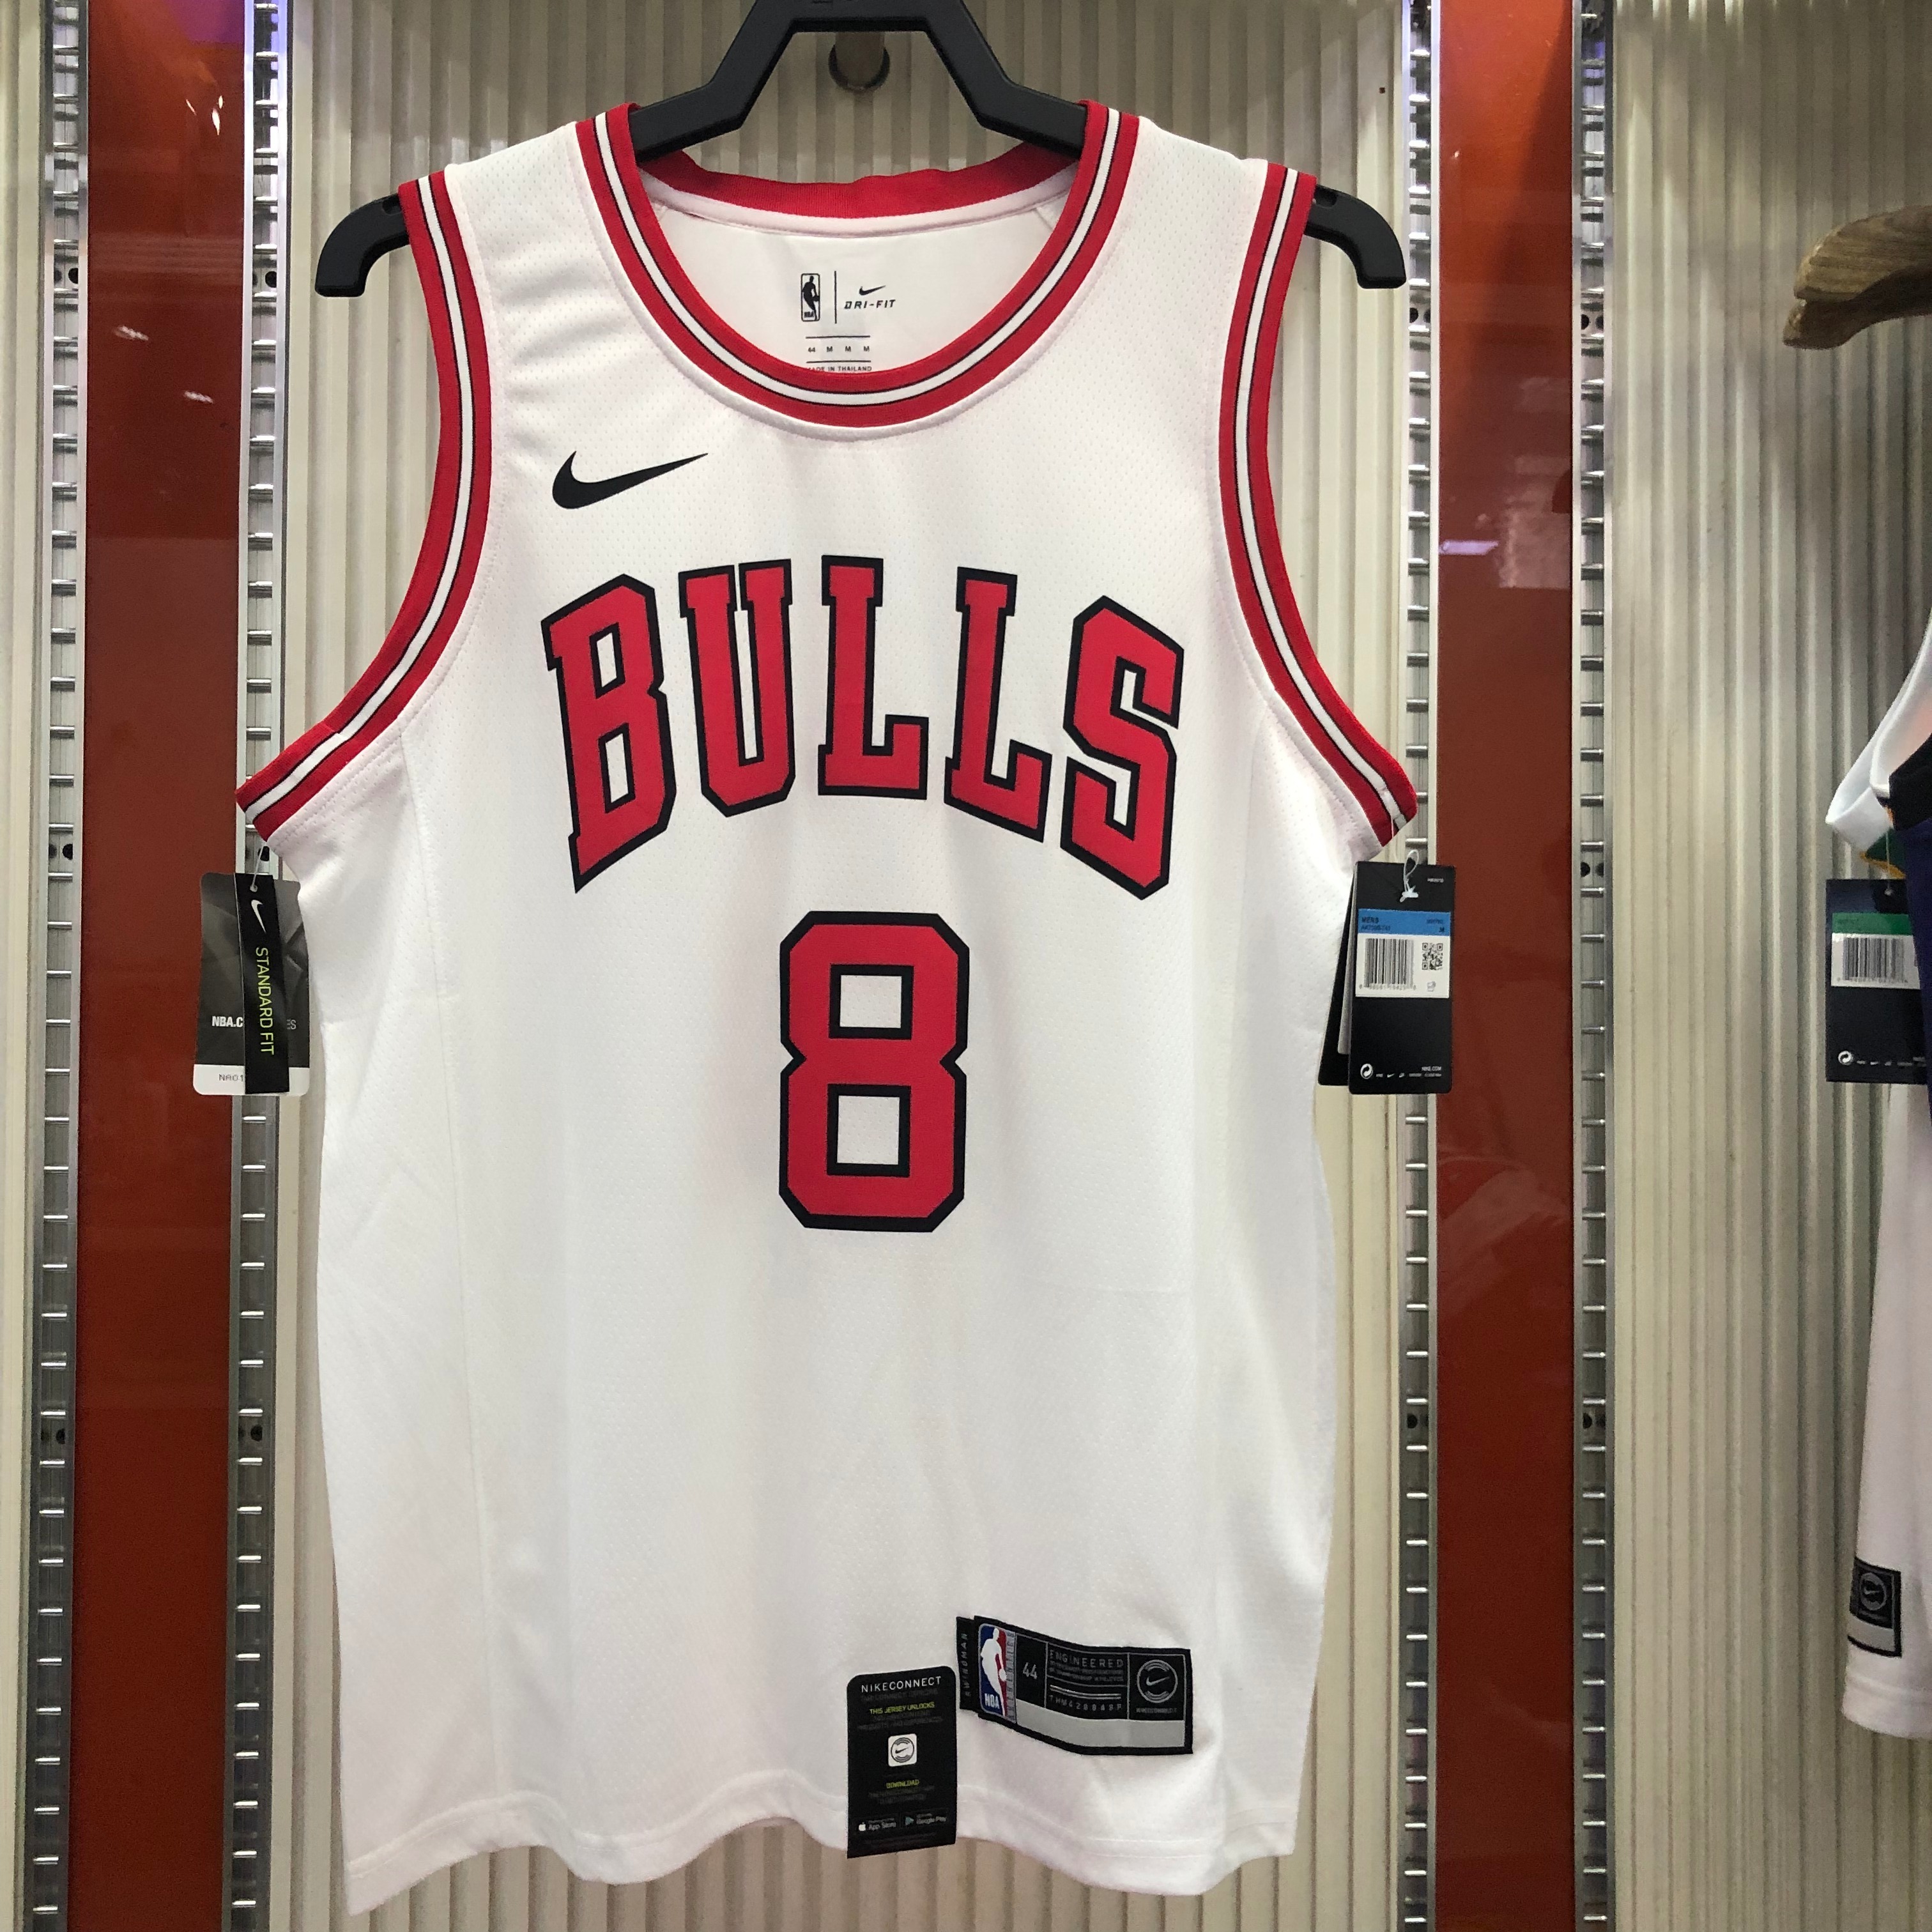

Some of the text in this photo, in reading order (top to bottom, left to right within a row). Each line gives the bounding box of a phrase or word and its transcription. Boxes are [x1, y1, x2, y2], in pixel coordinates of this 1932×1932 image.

[843, 300, 896, 310] DRI-FIT
[541, 555, 1184, 900] BULLS
[255, 947, 275, 1055] STANDARD FIT
[211, 1016, 243, 1027] NBA.C
[779, 910, 970, 1233] 8
[1049, 1649, 1124, 1667] ENGINEERED
[1022, 1662, 1038, 1680] 44
[861, 1675, 942, 1693] NIKECONNECT
[884, 1705, 906, 1713] JERSEY
[907, 1701, 935, 1711] UNLOCKS
[985, 1693, 1000, 1710] NBA
[885, 1779, 920, 1789] DOWNLOAD
